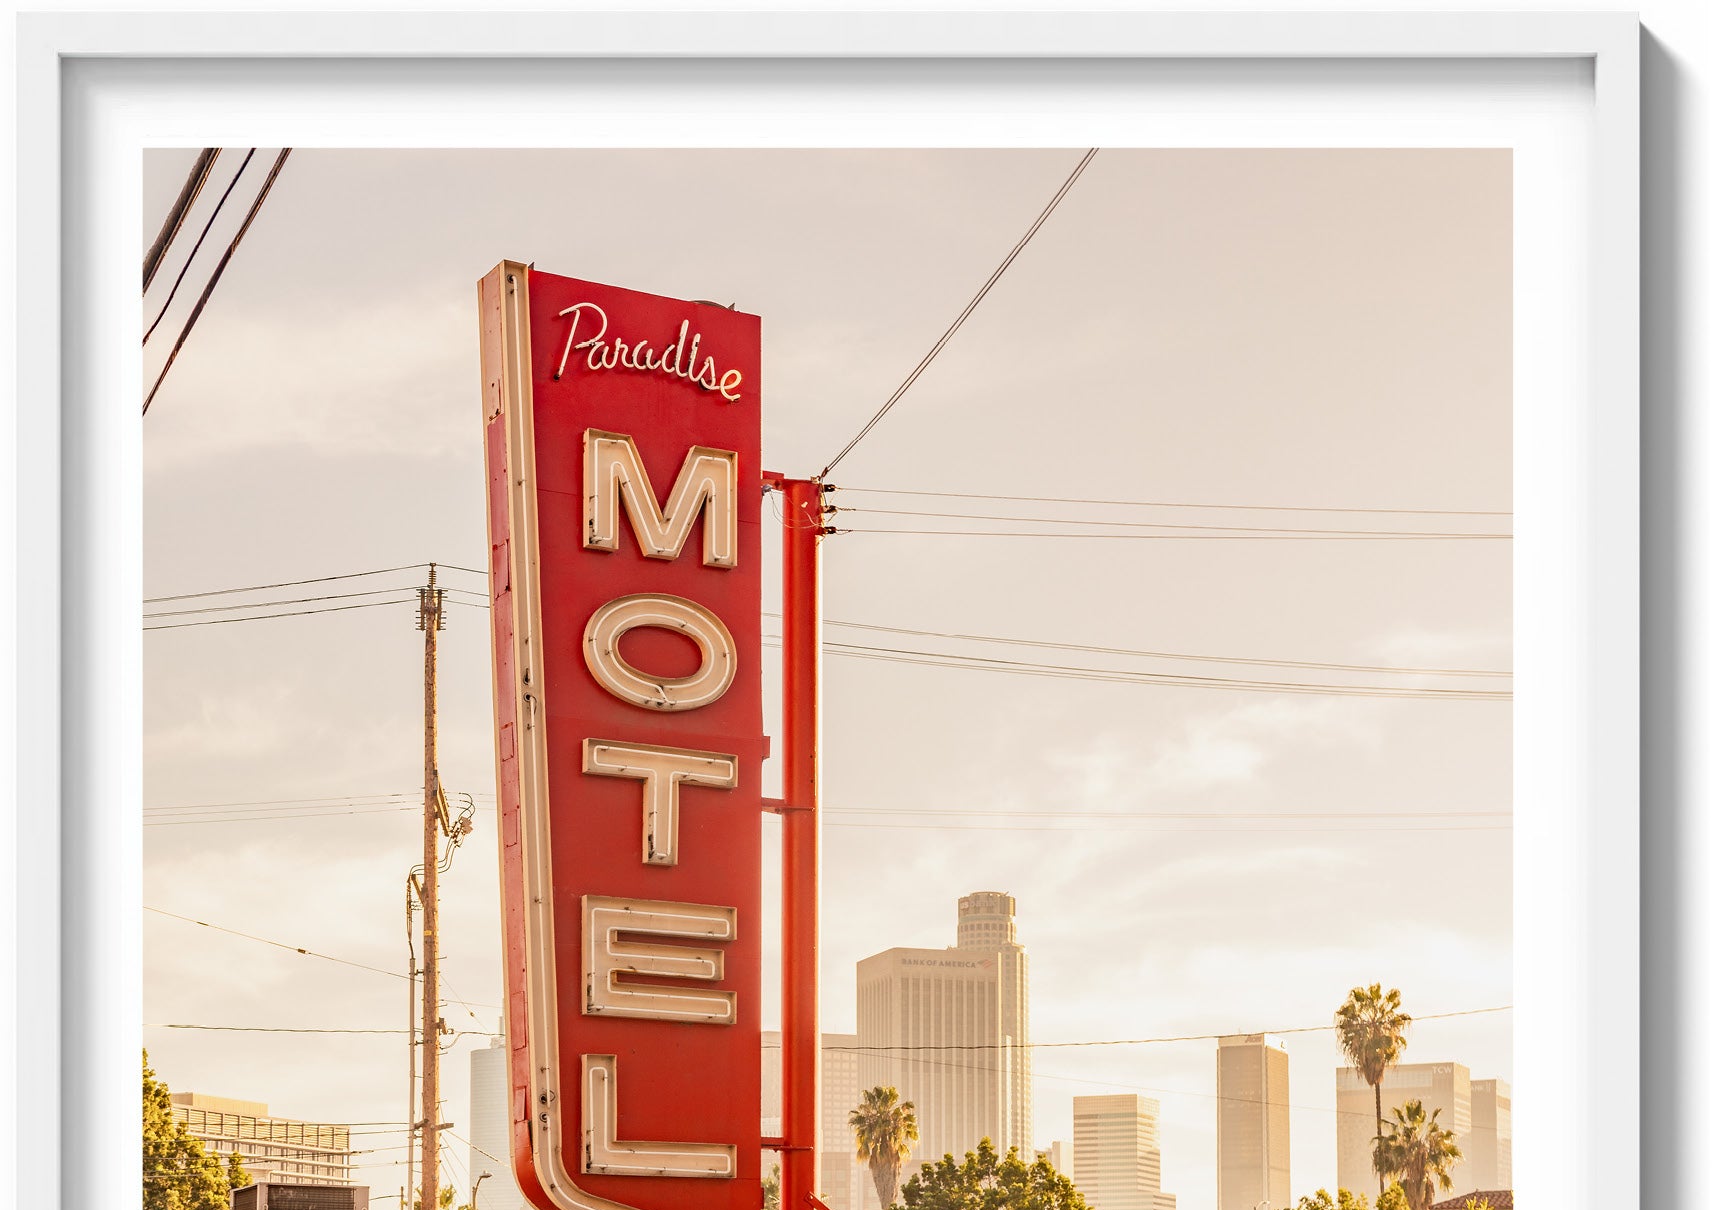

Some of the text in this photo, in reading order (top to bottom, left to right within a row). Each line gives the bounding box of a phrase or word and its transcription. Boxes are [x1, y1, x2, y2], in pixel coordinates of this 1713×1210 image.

[555, 302, 742, 402] Paradise
[581, 427, 739, 1179] MOTEL
[901, 958, 925, 966] BANK
[939, 960, 976, 968] AMERICA
[1432, 1066, 1453, 1074] TCW
